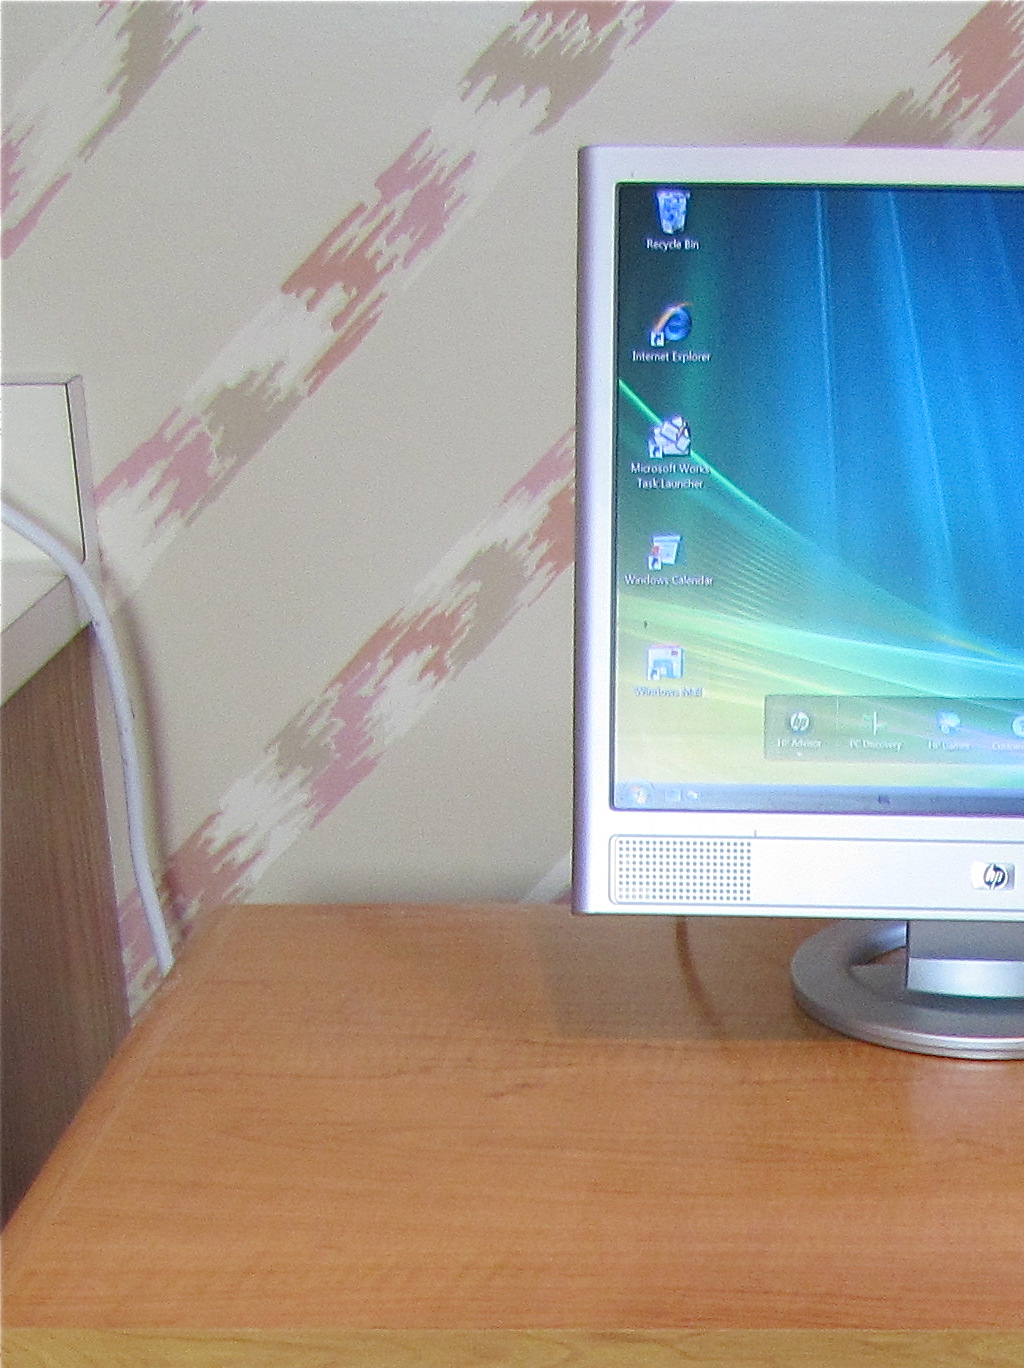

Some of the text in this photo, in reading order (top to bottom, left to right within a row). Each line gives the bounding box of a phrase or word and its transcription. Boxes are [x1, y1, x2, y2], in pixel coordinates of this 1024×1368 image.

[646, 239, 700, 250] Recycle Bin
[632, 351, 711, 365] Internet Explorer
[630, 462, 711, 474] Microsoft Works
[637, 478, 703, 490] Task Launcher
[624, 574, 713, 586] Windows Calendar
[634, 687, 680, 698] Windows
[850, 739, 903, 752] PC Discovery
